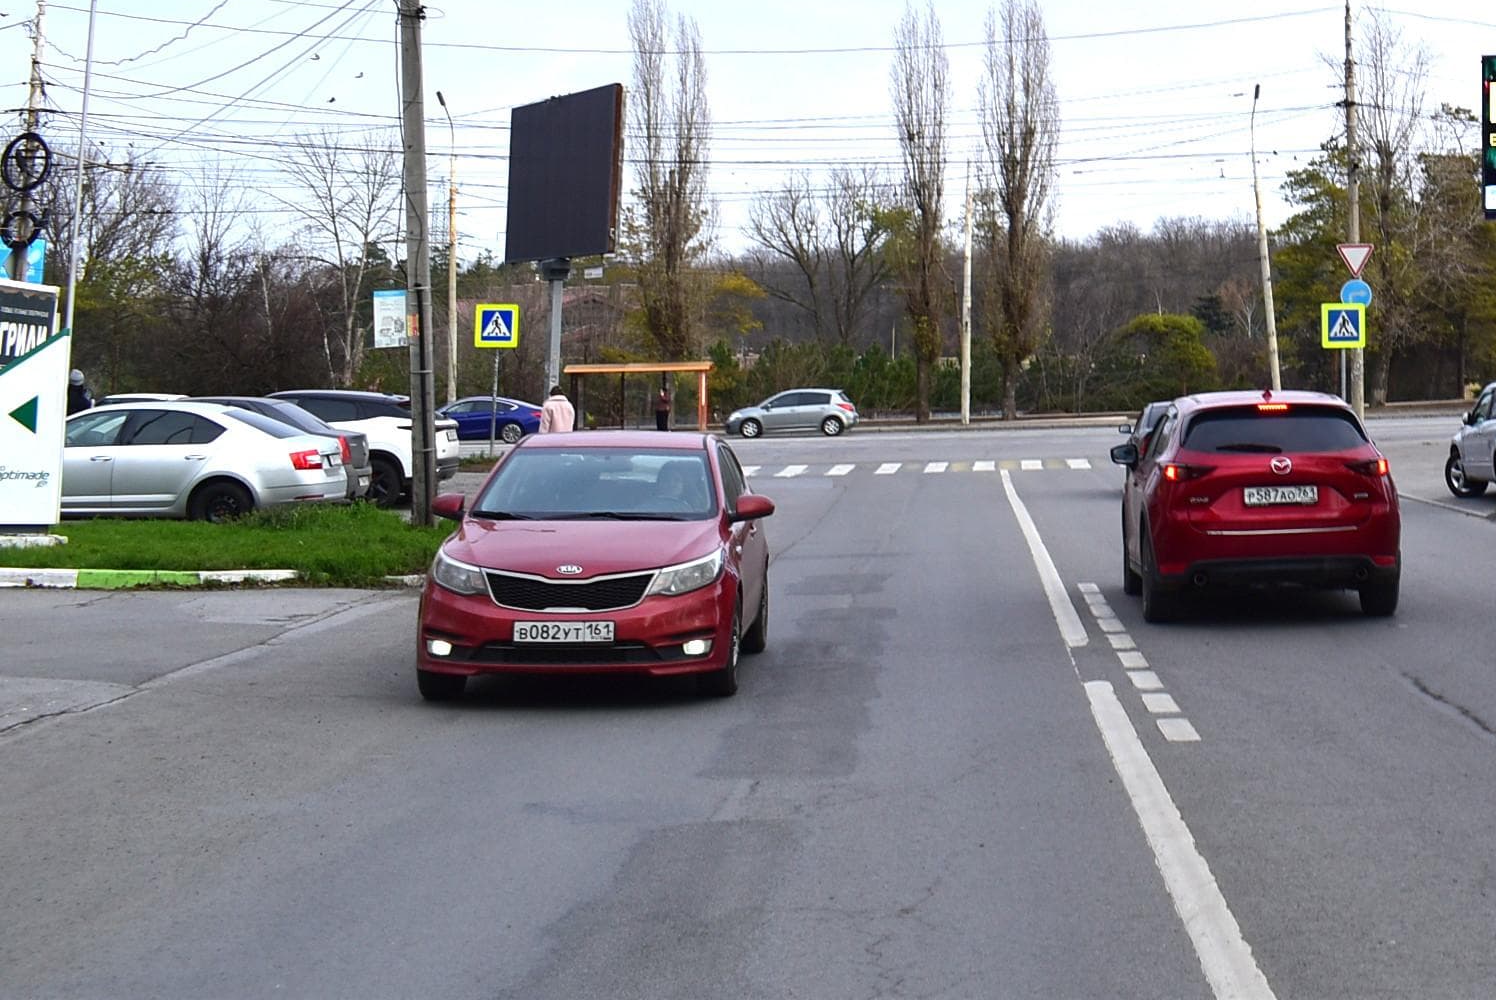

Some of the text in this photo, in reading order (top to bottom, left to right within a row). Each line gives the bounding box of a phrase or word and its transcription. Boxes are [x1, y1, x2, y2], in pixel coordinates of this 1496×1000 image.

[560, 565, 580, 574] KIA
[519, 623, 611, 640] В082УТ 161
